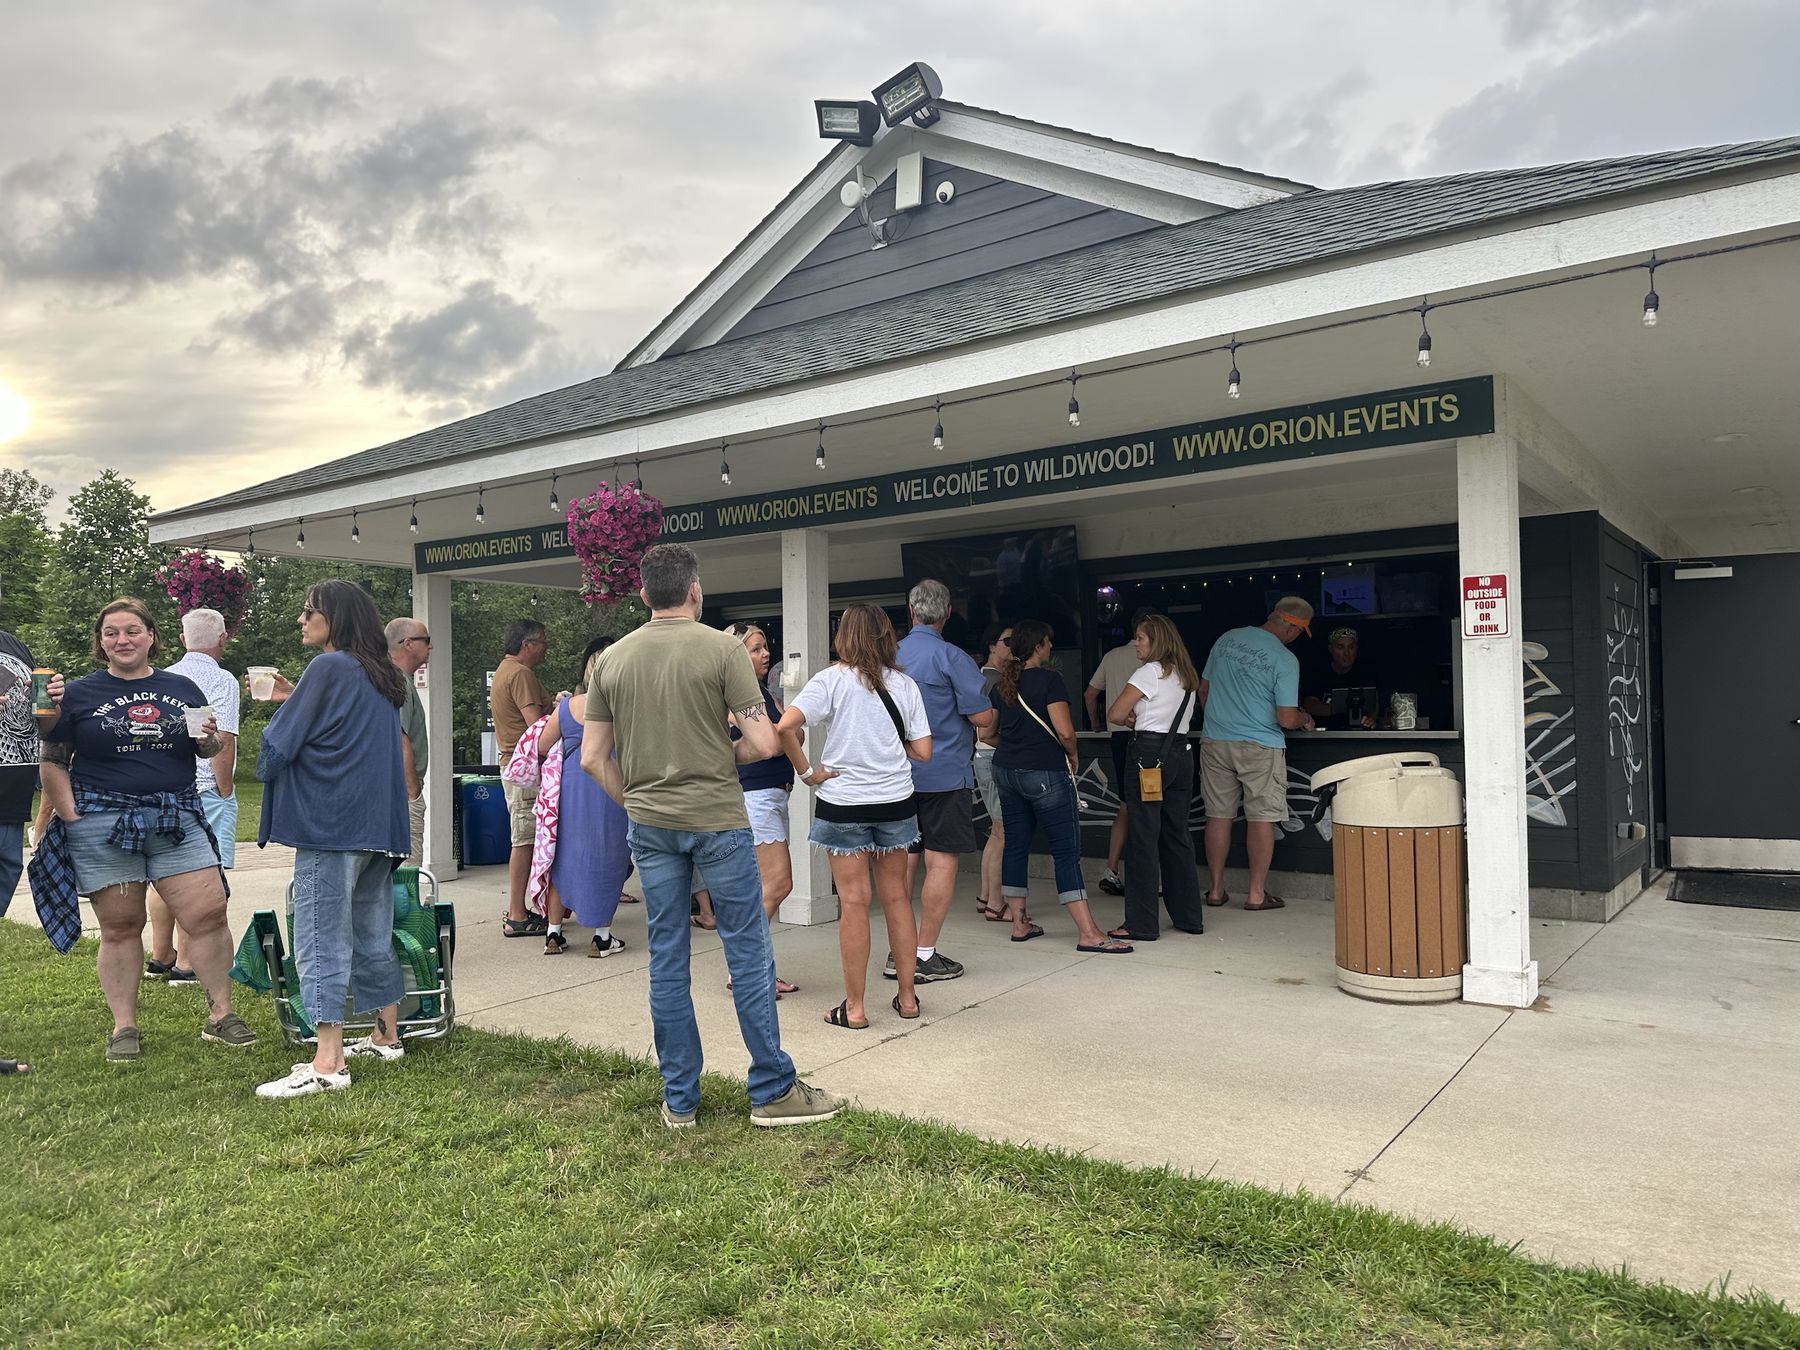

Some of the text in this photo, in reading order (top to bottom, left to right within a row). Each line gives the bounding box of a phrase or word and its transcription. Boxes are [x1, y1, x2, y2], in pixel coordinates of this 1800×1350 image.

[1173, 394, 1459, 461] WWW.ORION.EVENTS
[894, 442, 1154, 502] WELCOME TO WILDWOOD!
[717, 487, 877, 526] WWW.ORION.EVENTS
[425, 535, 531, 563] WWW.ORION.EVENTS
[1479, 577, 1490, 586] NO
[1467, 588, 1502, 599] OUTSIDE
[1475, 601, 1496, 610] FOOD
[1479, 613, 1491, 621] OR
[1473, 624, 1499, 633] DRINK
[93, 692, 190, 717] THE BLACK KEYS
[116, 745, 141, 753] TOUR
